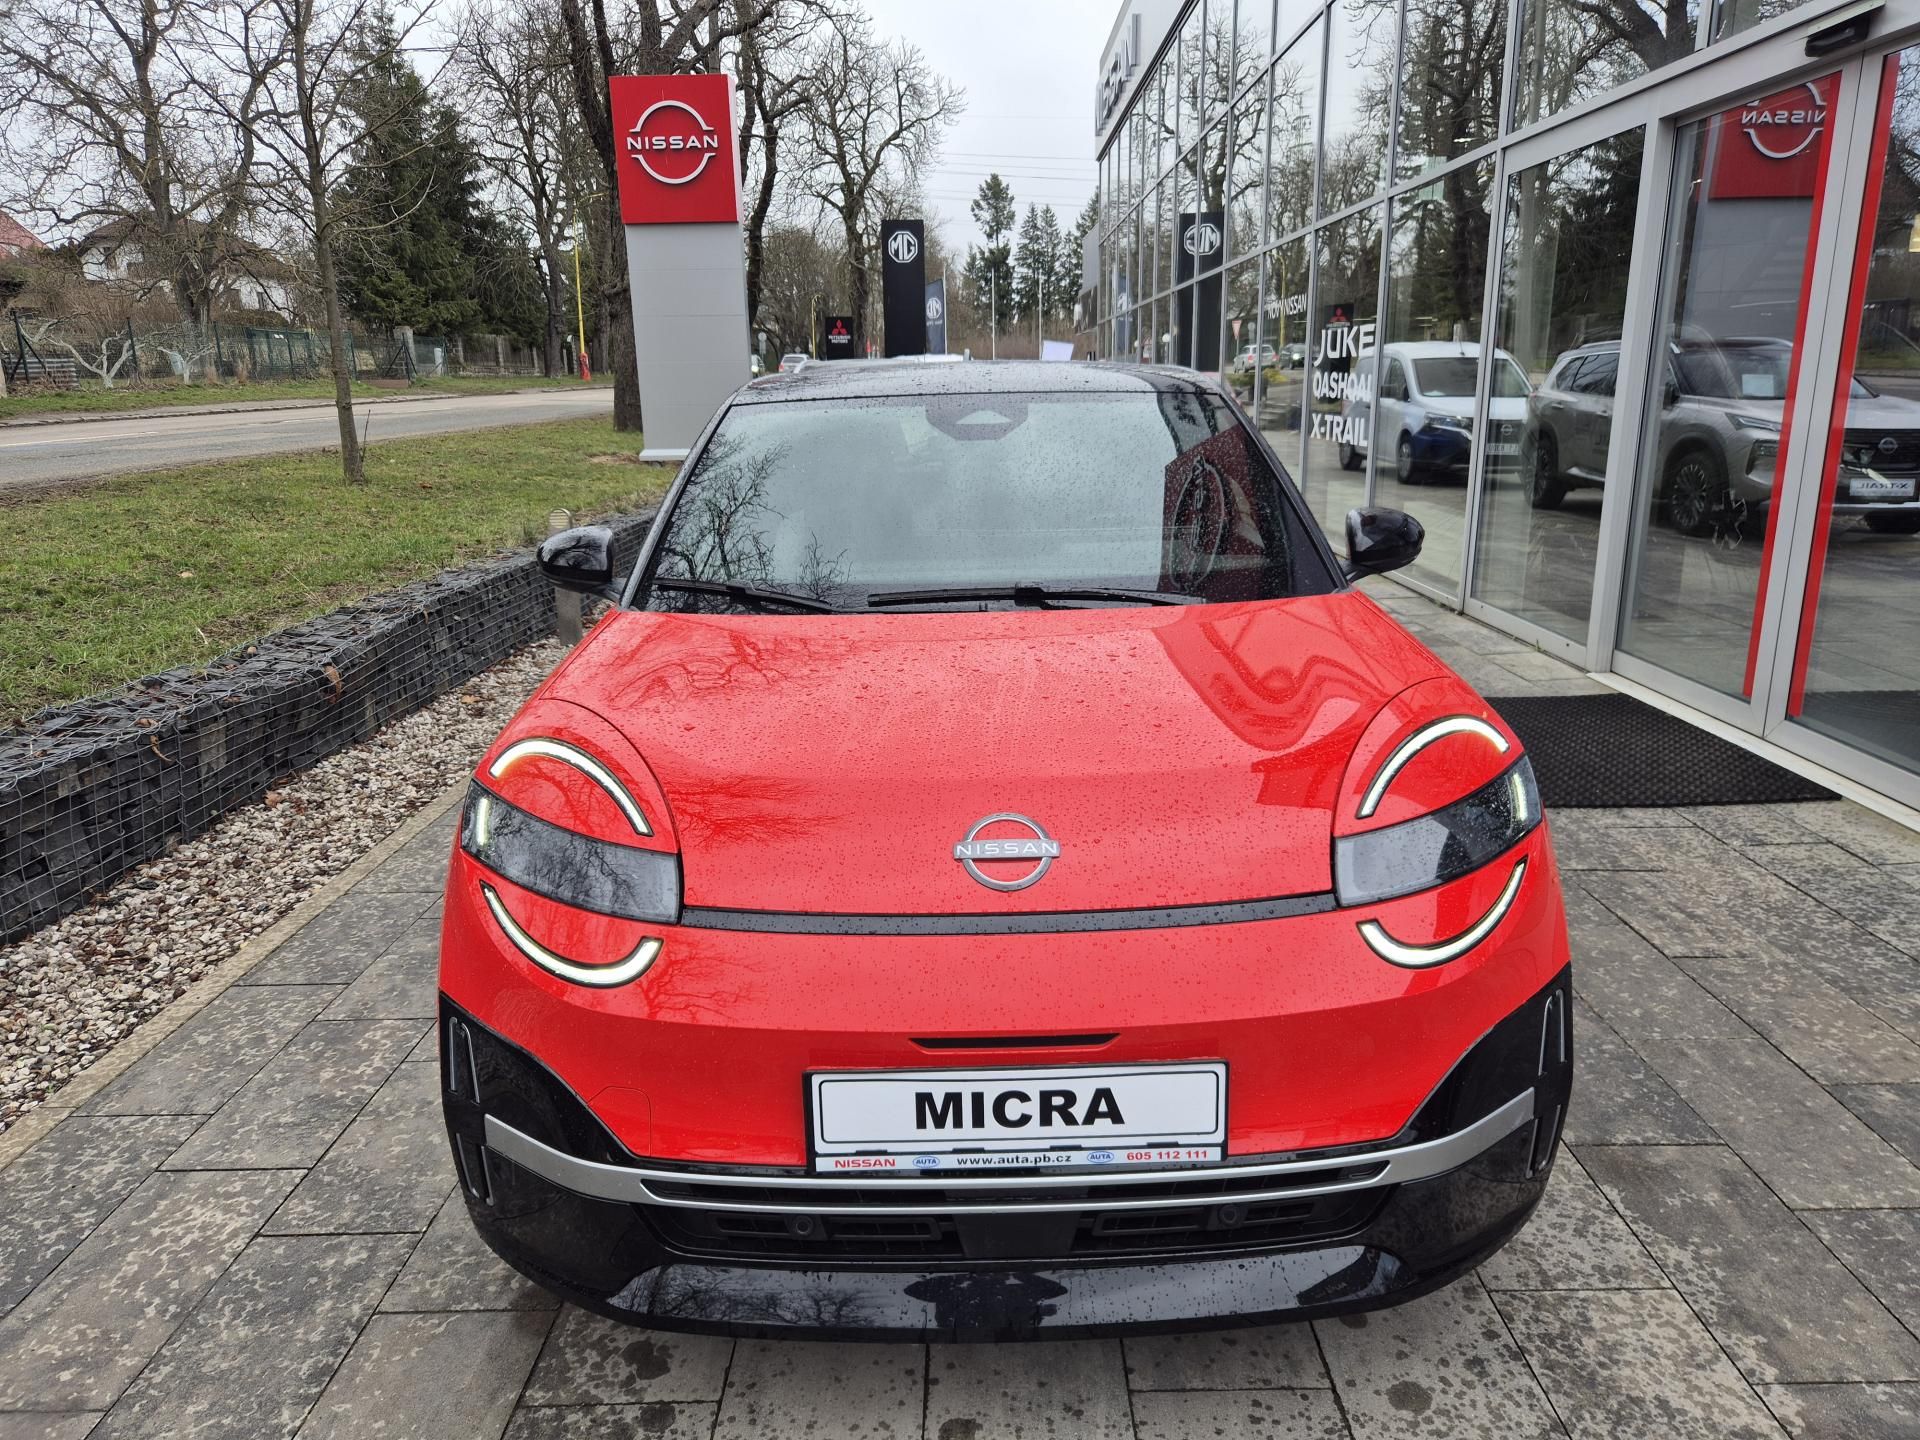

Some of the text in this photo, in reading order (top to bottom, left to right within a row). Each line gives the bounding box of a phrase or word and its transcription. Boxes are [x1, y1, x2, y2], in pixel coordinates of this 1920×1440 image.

[626, 135, 718, 150] NISSAN
[889, 233, 917, 262] MG
[1313, 323, 1376, 367] JUKE
[1312, 371, 1373, 403] QASHQAI
[1310, 413, 1368, 447] X-TRAIL
[956, 842, 1057, 856] NISSAN
[914, 1087, 1126, 1130] MICRA
[834, 1158, 896, 1168] NISSAN
[956, 1154, 1072, 1165] www.auta.pb.cz
[1126, 1152, 1152, 1161] 605
[1156, 1151, 1181, 1160] 112
[1186, 1150, 1208, 1159] 111
